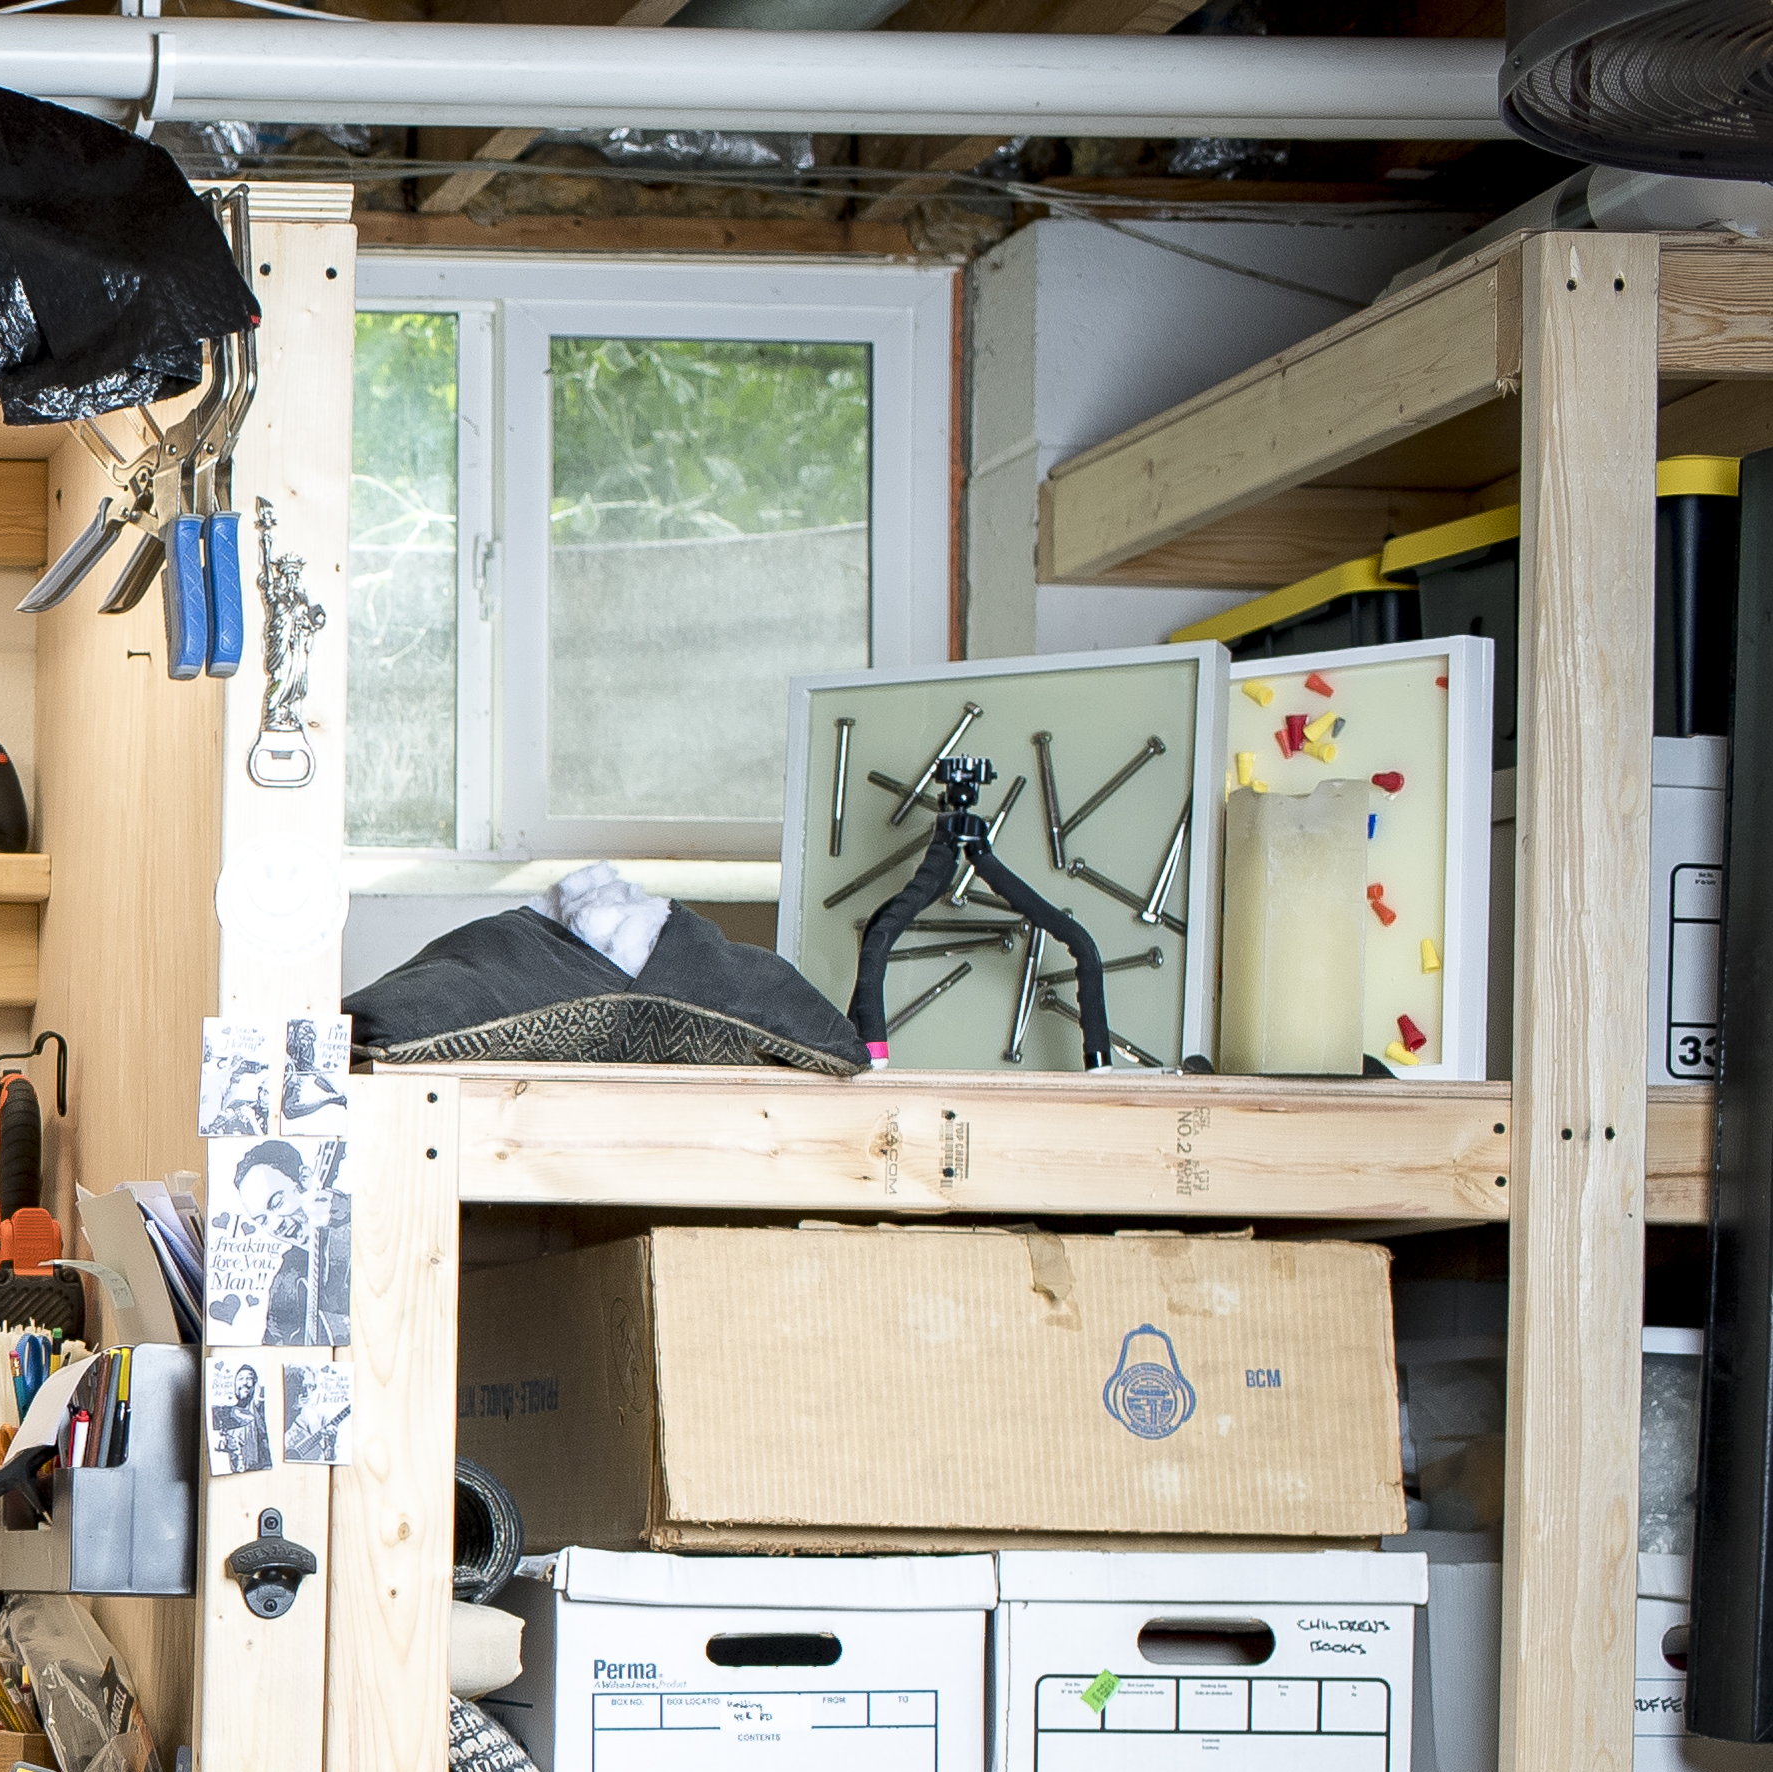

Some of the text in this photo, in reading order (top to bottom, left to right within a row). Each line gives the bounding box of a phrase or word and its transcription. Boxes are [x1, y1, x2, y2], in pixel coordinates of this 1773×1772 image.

[1176, 1110, 1192, 1154] NO.2
[210, 1236, 281, 1258] Freaking
[209, 1254, 241, 1271] Love
[210, 1272, 267, 1291] Man!!
[1245, 1368, 1281, 1388] BCM
[1310, 1640, 1367, 1655] BOOKS
[593, 1659, 657, 1679] Perma
[667, 1698, 684, 1706] BOX
[822, 1696, 847, 1704] FROM
[737, 1733, 781, 1742] CONTENTS
